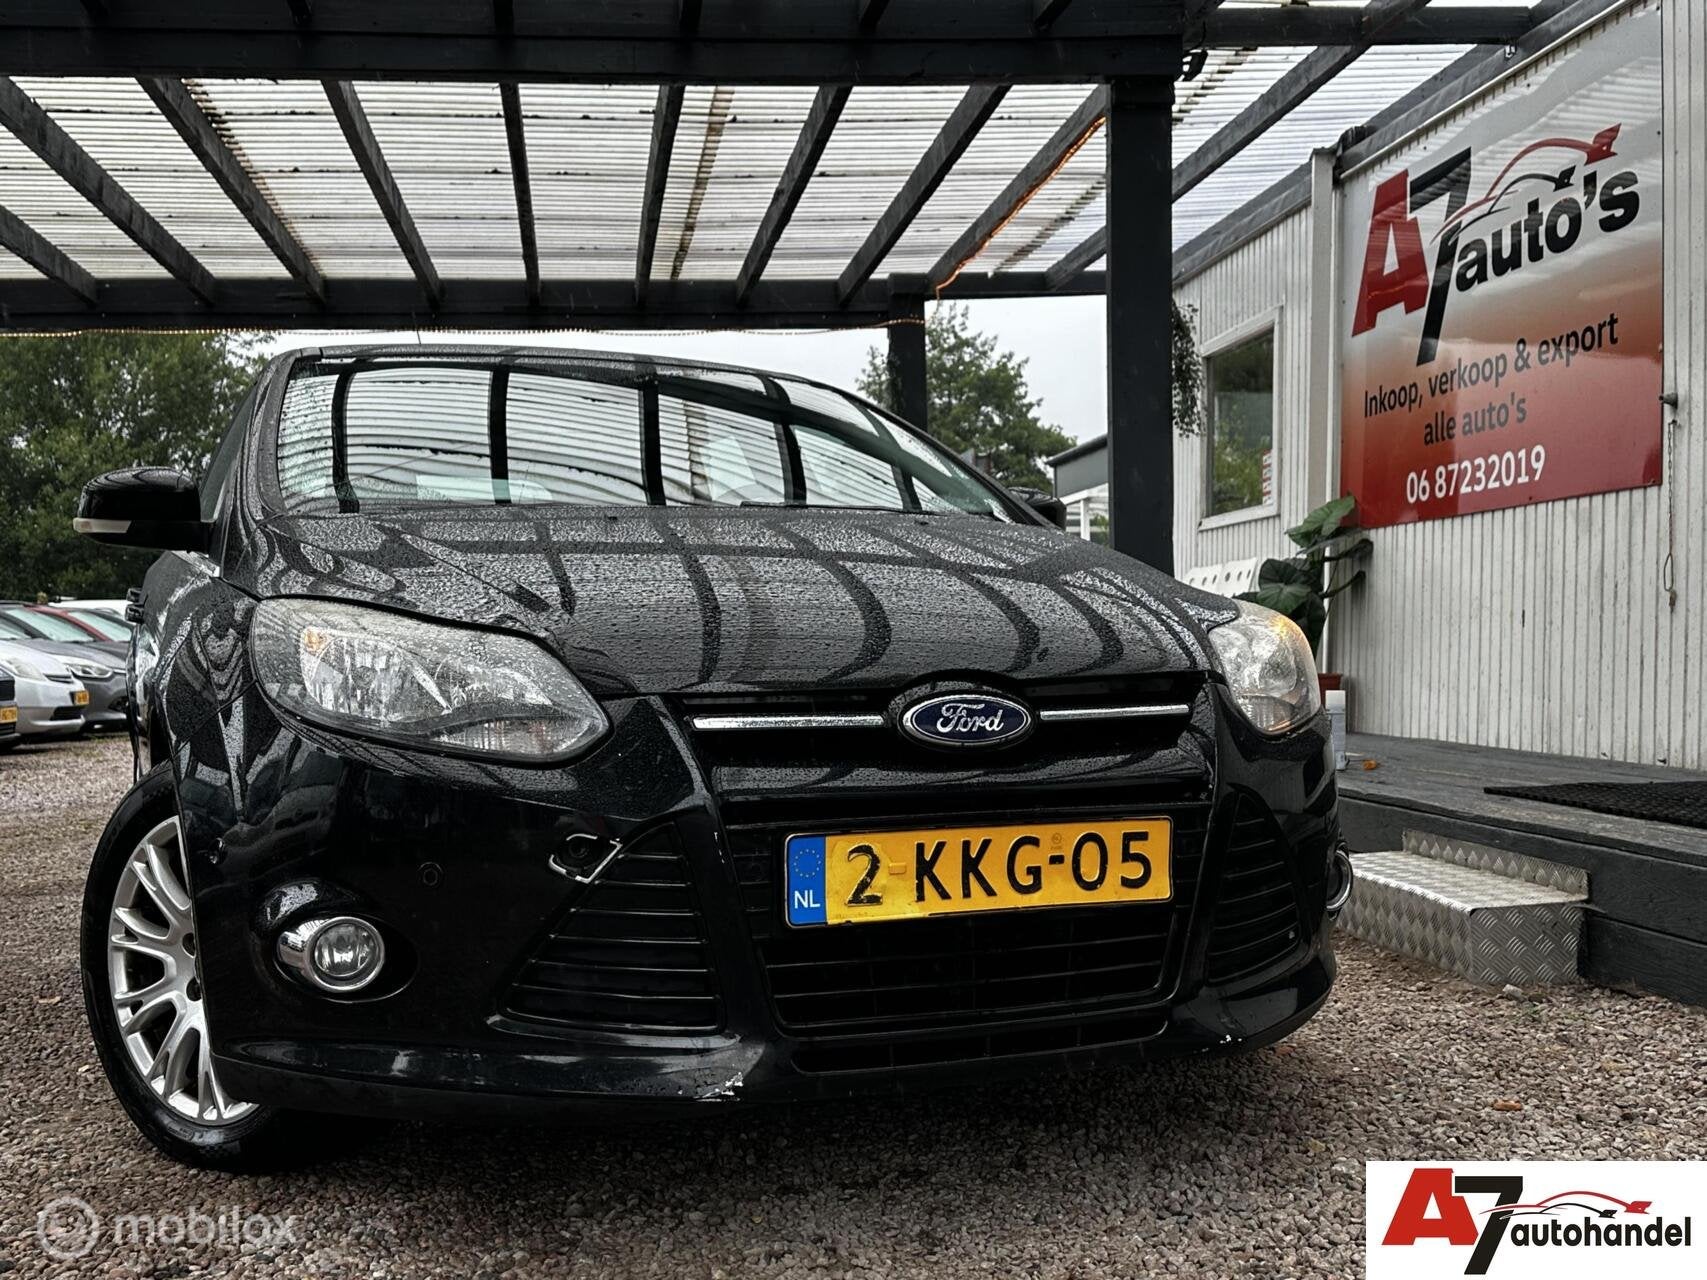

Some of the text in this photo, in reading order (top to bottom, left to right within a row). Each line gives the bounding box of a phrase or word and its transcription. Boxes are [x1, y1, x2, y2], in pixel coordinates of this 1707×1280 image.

[1352, 147, 1640, 367] A7 auto's
[1364, 312, 1619, 418] Inkoop, verkoop & export
[1423, 394, 1527, 445] alle auto's
[1406, 445, 1546, 503] 06 87232019
[936, 702, 1003, 733] Ford
[794, 890, 820, 909] NL
